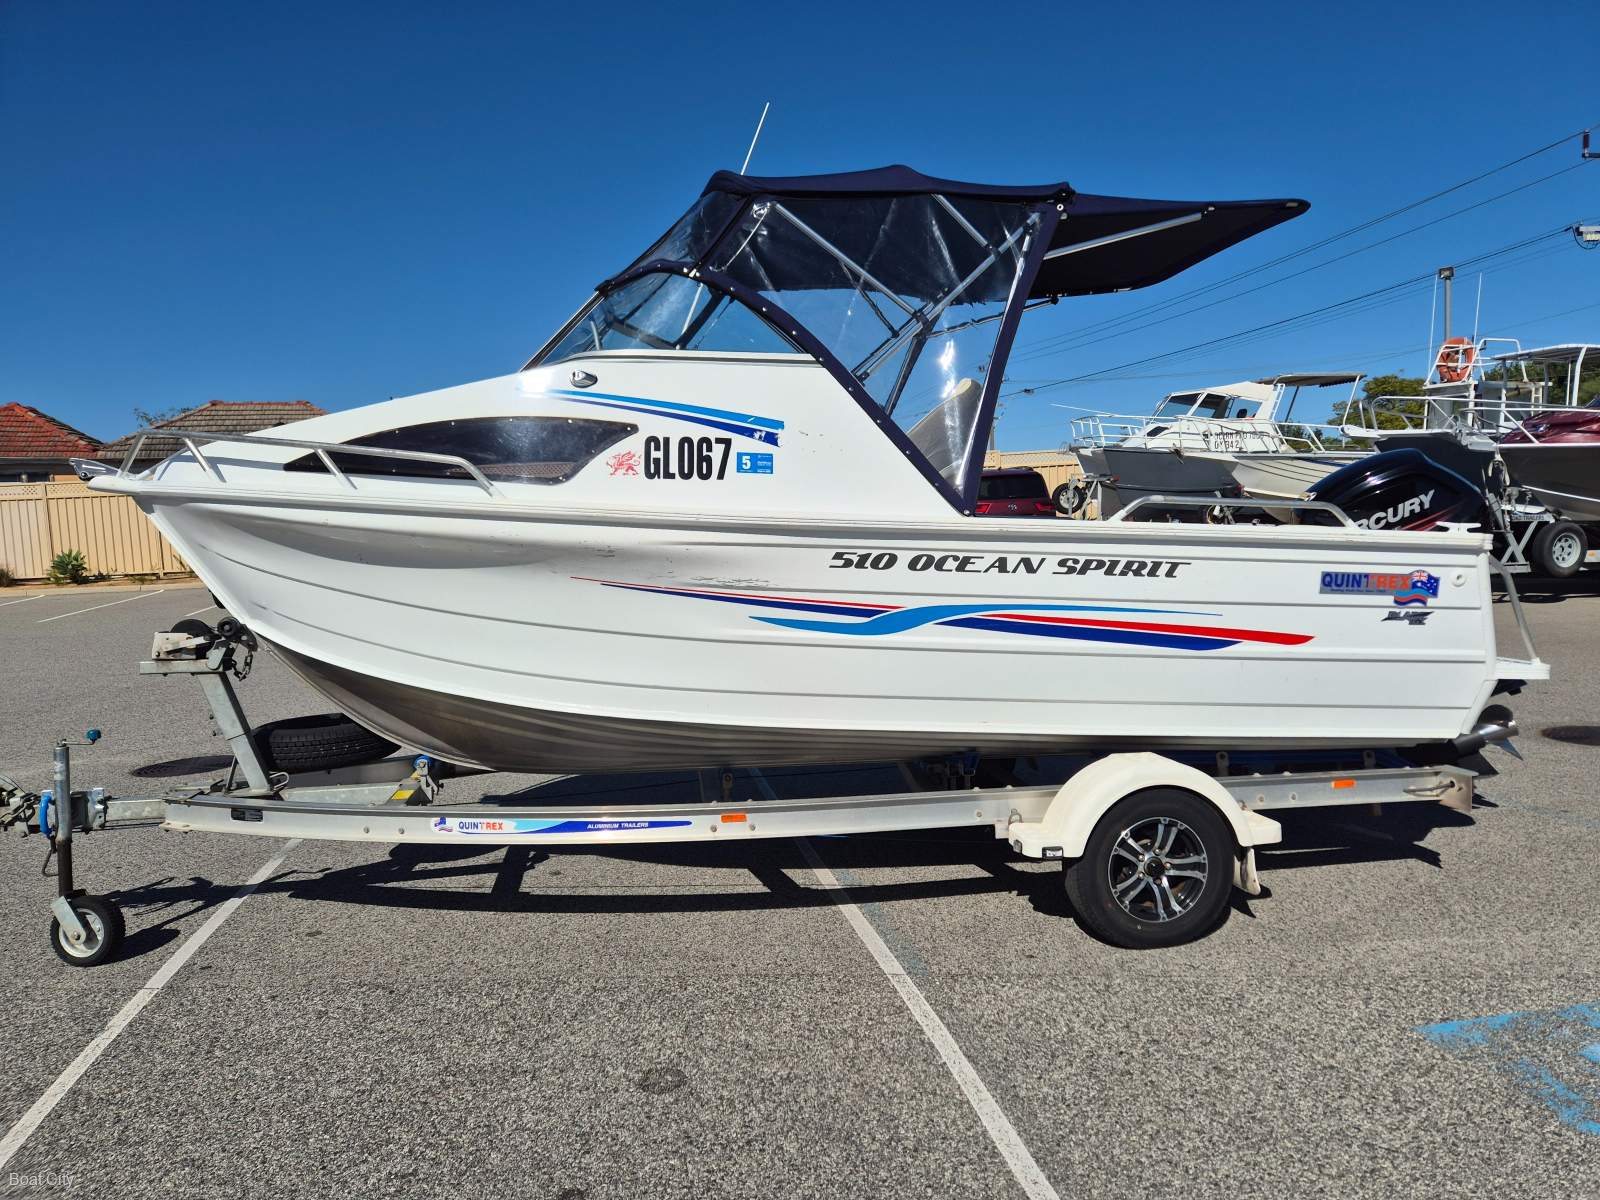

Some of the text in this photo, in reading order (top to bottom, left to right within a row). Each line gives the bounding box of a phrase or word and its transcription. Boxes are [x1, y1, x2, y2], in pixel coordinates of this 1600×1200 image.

[742, 455, 751, 470] 5
[1353, 489, 1435, 530] RCURY
[829, 551, 1193, 578] 510 OCEAN SPIRIT
[1321, 572, 1410, 591] QUINTREX
[458, 821, 504, 830] QUINTREX
